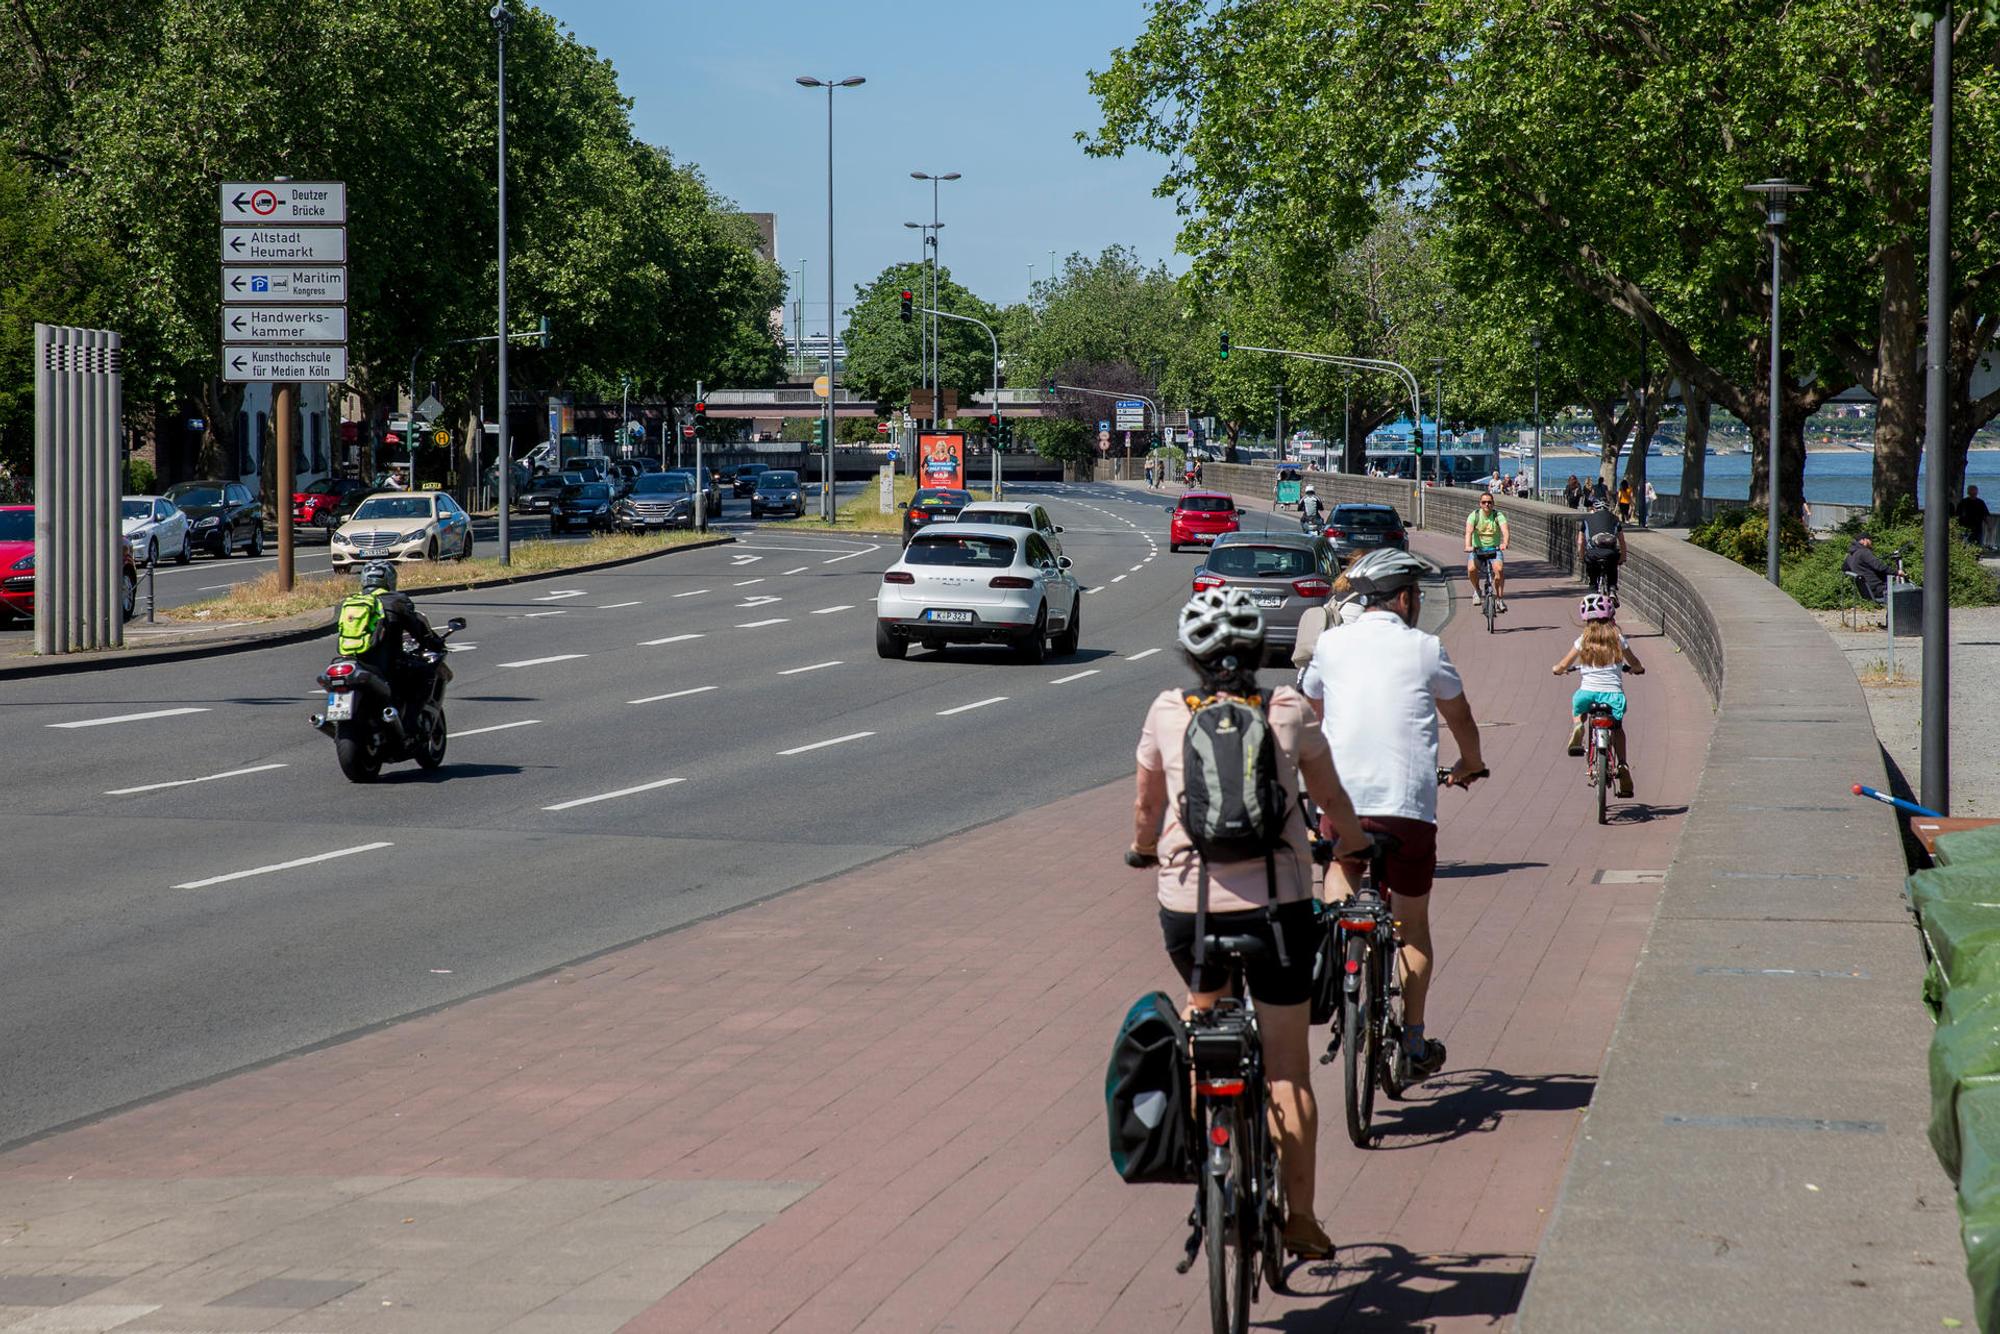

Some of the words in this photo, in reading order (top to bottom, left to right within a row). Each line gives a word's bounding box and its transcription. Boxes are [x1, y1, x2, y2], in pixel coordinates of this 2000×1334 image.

[292, 190, 328, 201] Deutzer
[293, 205, 325, 216] Brücke
[252, 233, 300, 243] Altstadt
[251, 247, 313, 257] Heumarkt
[293, 273, 341, 283] Maritim
[293, 287, 325, 297] Kongress
[252, 312, 329, 323] Handwerks-
[252, 326, 305, 337] kammer
[252, 352, 331, 363] Kunsthochschule
[253, 366, 266, 376] für
[272, 366, 305, 377] Medien
[310, 366, 329, 377] Köln
